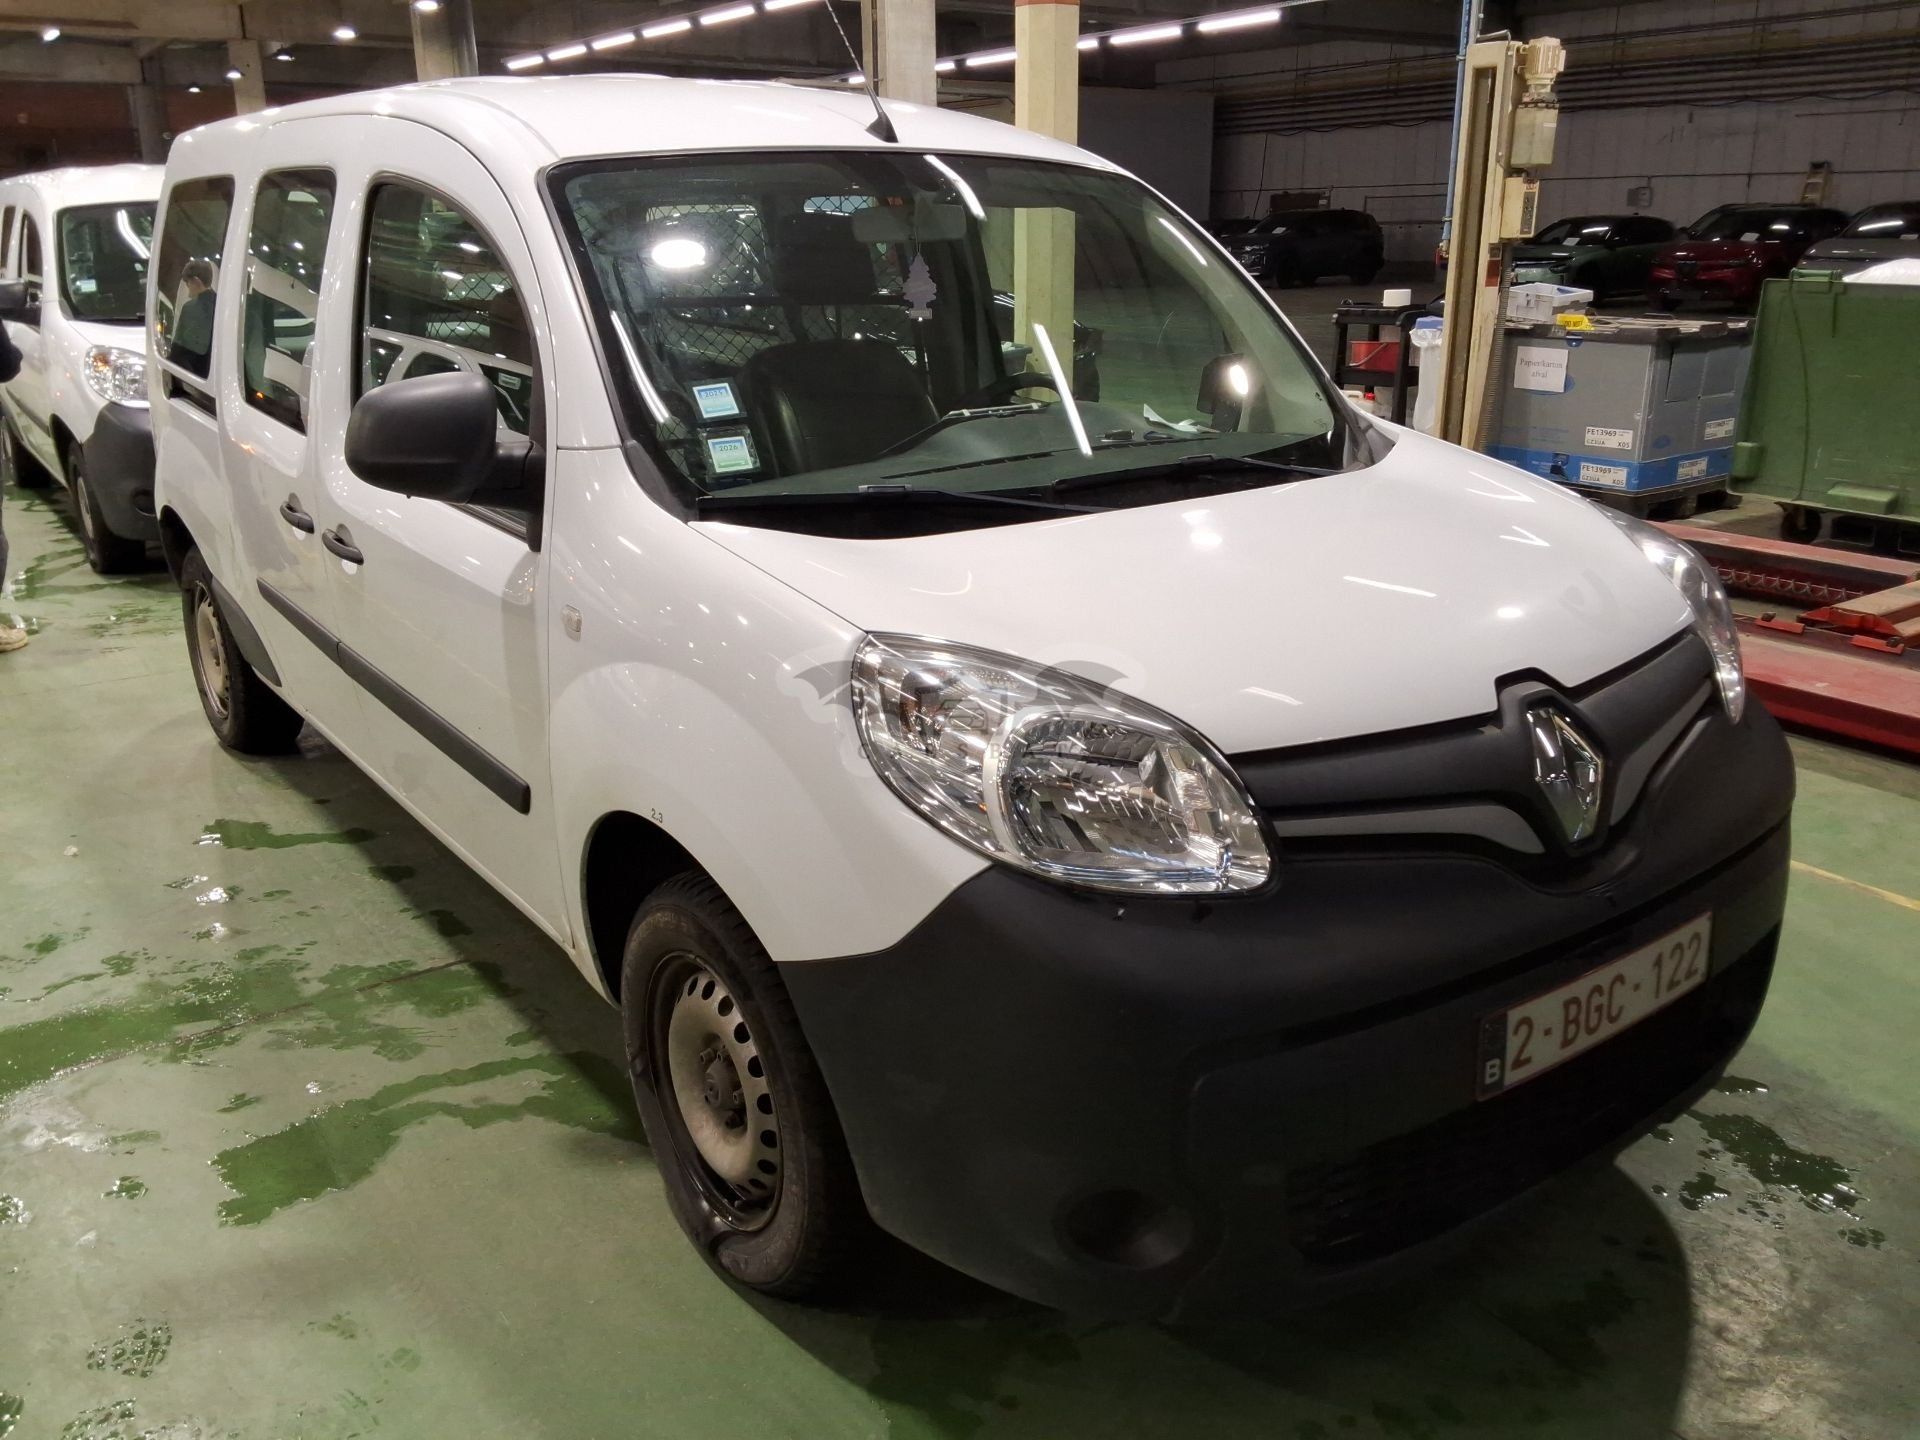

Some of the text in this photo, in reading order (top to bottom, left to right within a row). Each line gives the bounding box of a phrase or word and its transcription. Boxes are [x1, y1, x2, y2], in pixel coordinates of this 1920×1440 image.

[1586, 428, 1617, 437] FE13969
[719, 444, 738, 452] 2026
[1582, 464, 1612, 474] FE13969
[1511, 932, 1702, 1072] 2-BGC-122
[1485, 1058, 1501, 1085] B
